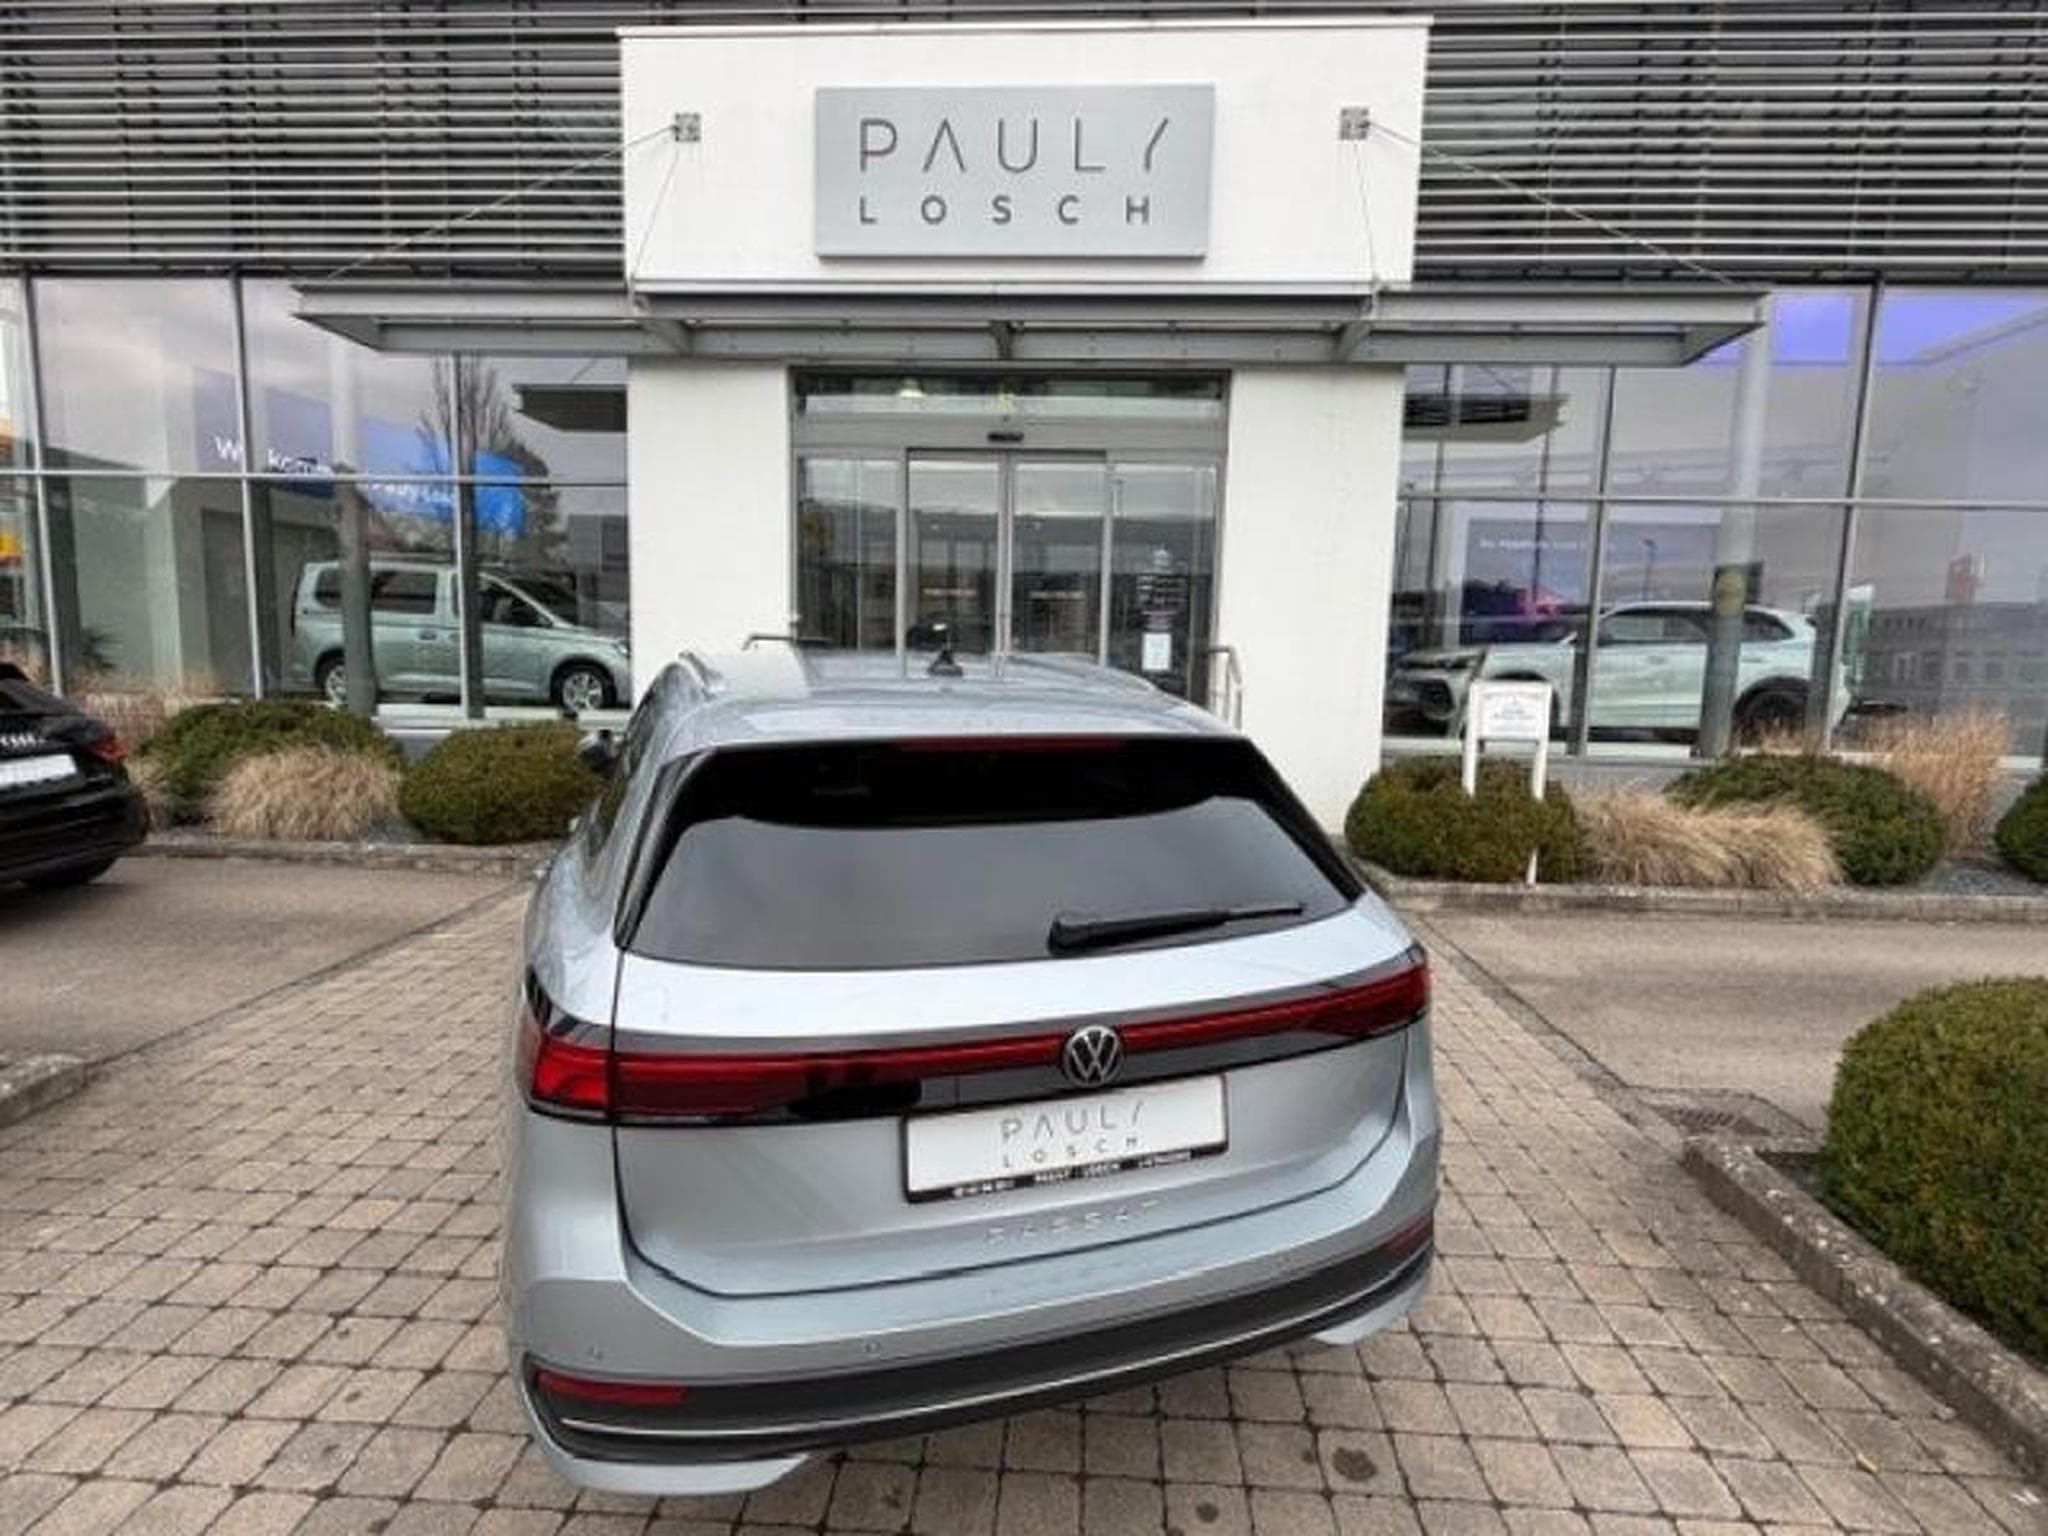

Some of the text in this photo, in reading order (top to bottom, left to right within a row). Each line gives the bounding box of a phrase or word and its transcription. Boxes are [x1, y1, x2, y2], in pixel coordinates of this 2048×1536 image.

[858, 117, 1169, 173] PAULY
[859, 194, 1151, 225] LOSCH
[1003, 1136, 1138, 1168] LOSCH
